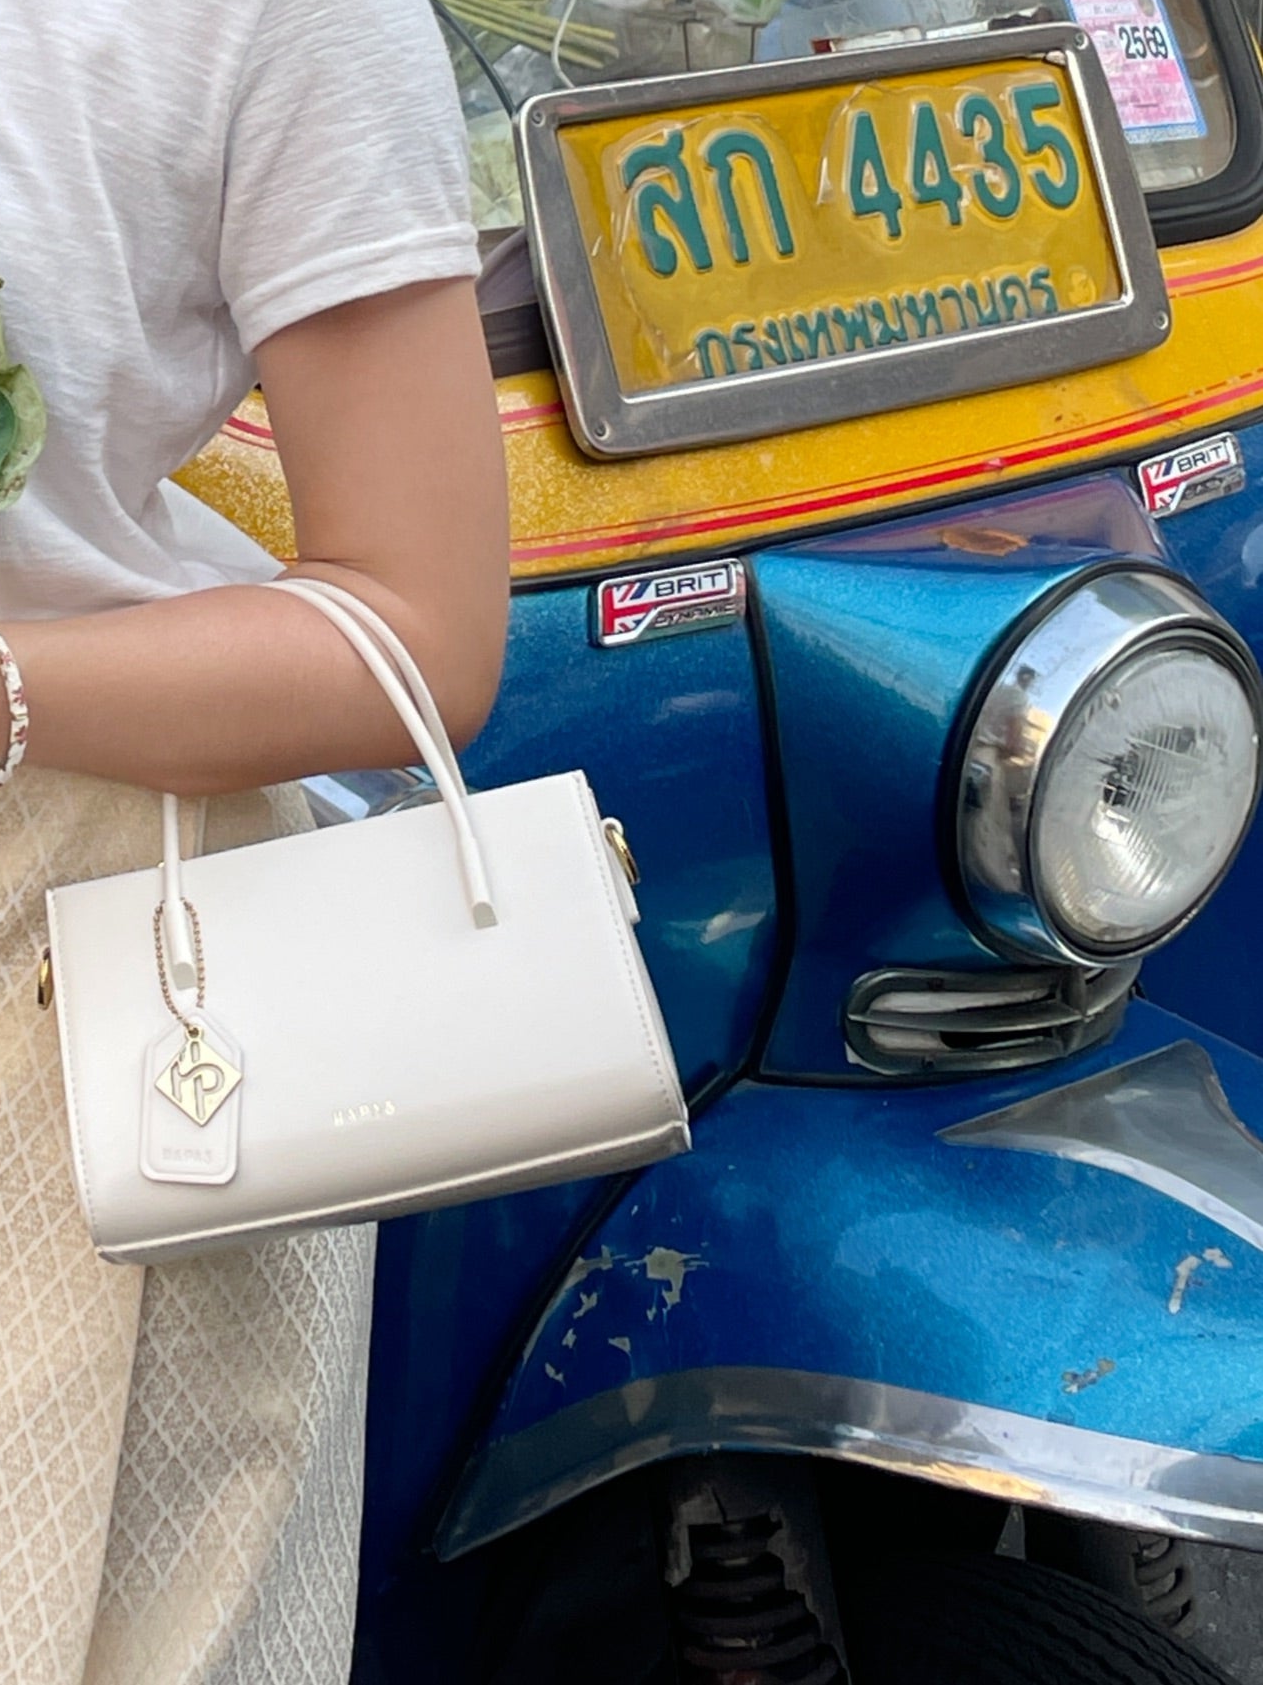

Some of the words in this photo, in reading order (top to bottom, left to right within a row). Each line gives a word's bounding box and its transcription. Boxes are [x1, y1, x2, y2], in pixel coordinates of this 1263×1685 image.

[1119, 26, 1168, 59] 2569
[622, 130, 795, 277] สก
[848, 82, 1079, 238] 4435
[695, 268, 1060, 379] กรงเทพมหานคร
[1177, 445, 1222, 472] BRIT
[655, 572, 723, 597] BRIT
